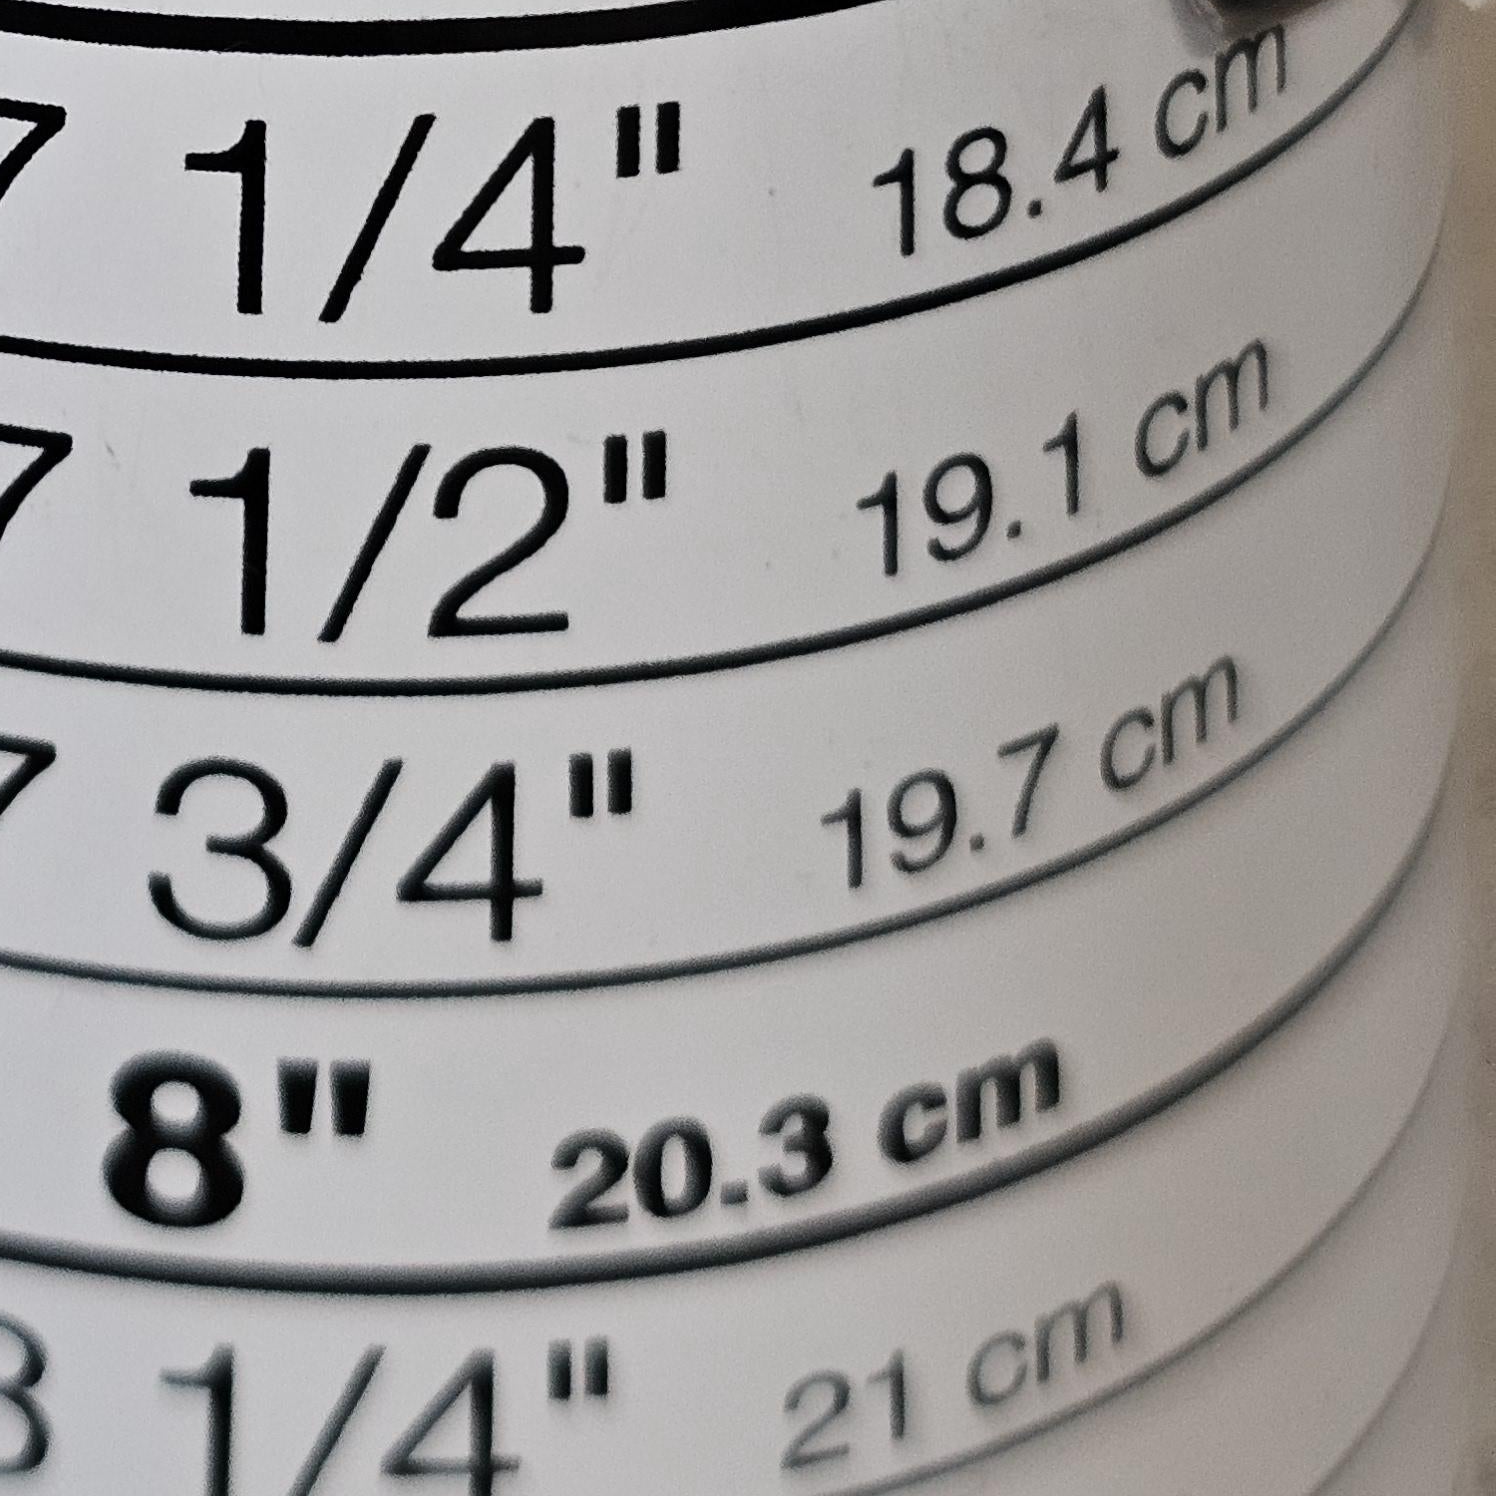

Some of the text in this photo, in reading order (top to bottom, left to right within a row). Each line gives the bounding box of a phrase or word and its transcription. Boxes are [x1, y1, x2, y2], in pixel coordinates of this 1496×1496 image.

[182, 99, 682, 326] 1/4"
[871, 83, 1122, 260] 18.4
[1154, 22, 1289, 160] cm
[187, 427, 669, 647] 1/2"
[855, 409, 1083, 579] 19.1
[1133, 337, 1272, 480] cm
[146, 746, 635, 952] 3/4"
[819, 721, 1061, 891] 19.7
[1099, 654, 1242, 794] cm
[101, 1040, 1066, 1235] 8" 20.3 cm
[162, 1339, 612, 1496] 1/4"
[781, 1348, 907, 1472] 21
[968, 1282, 1127, 1408] cm
